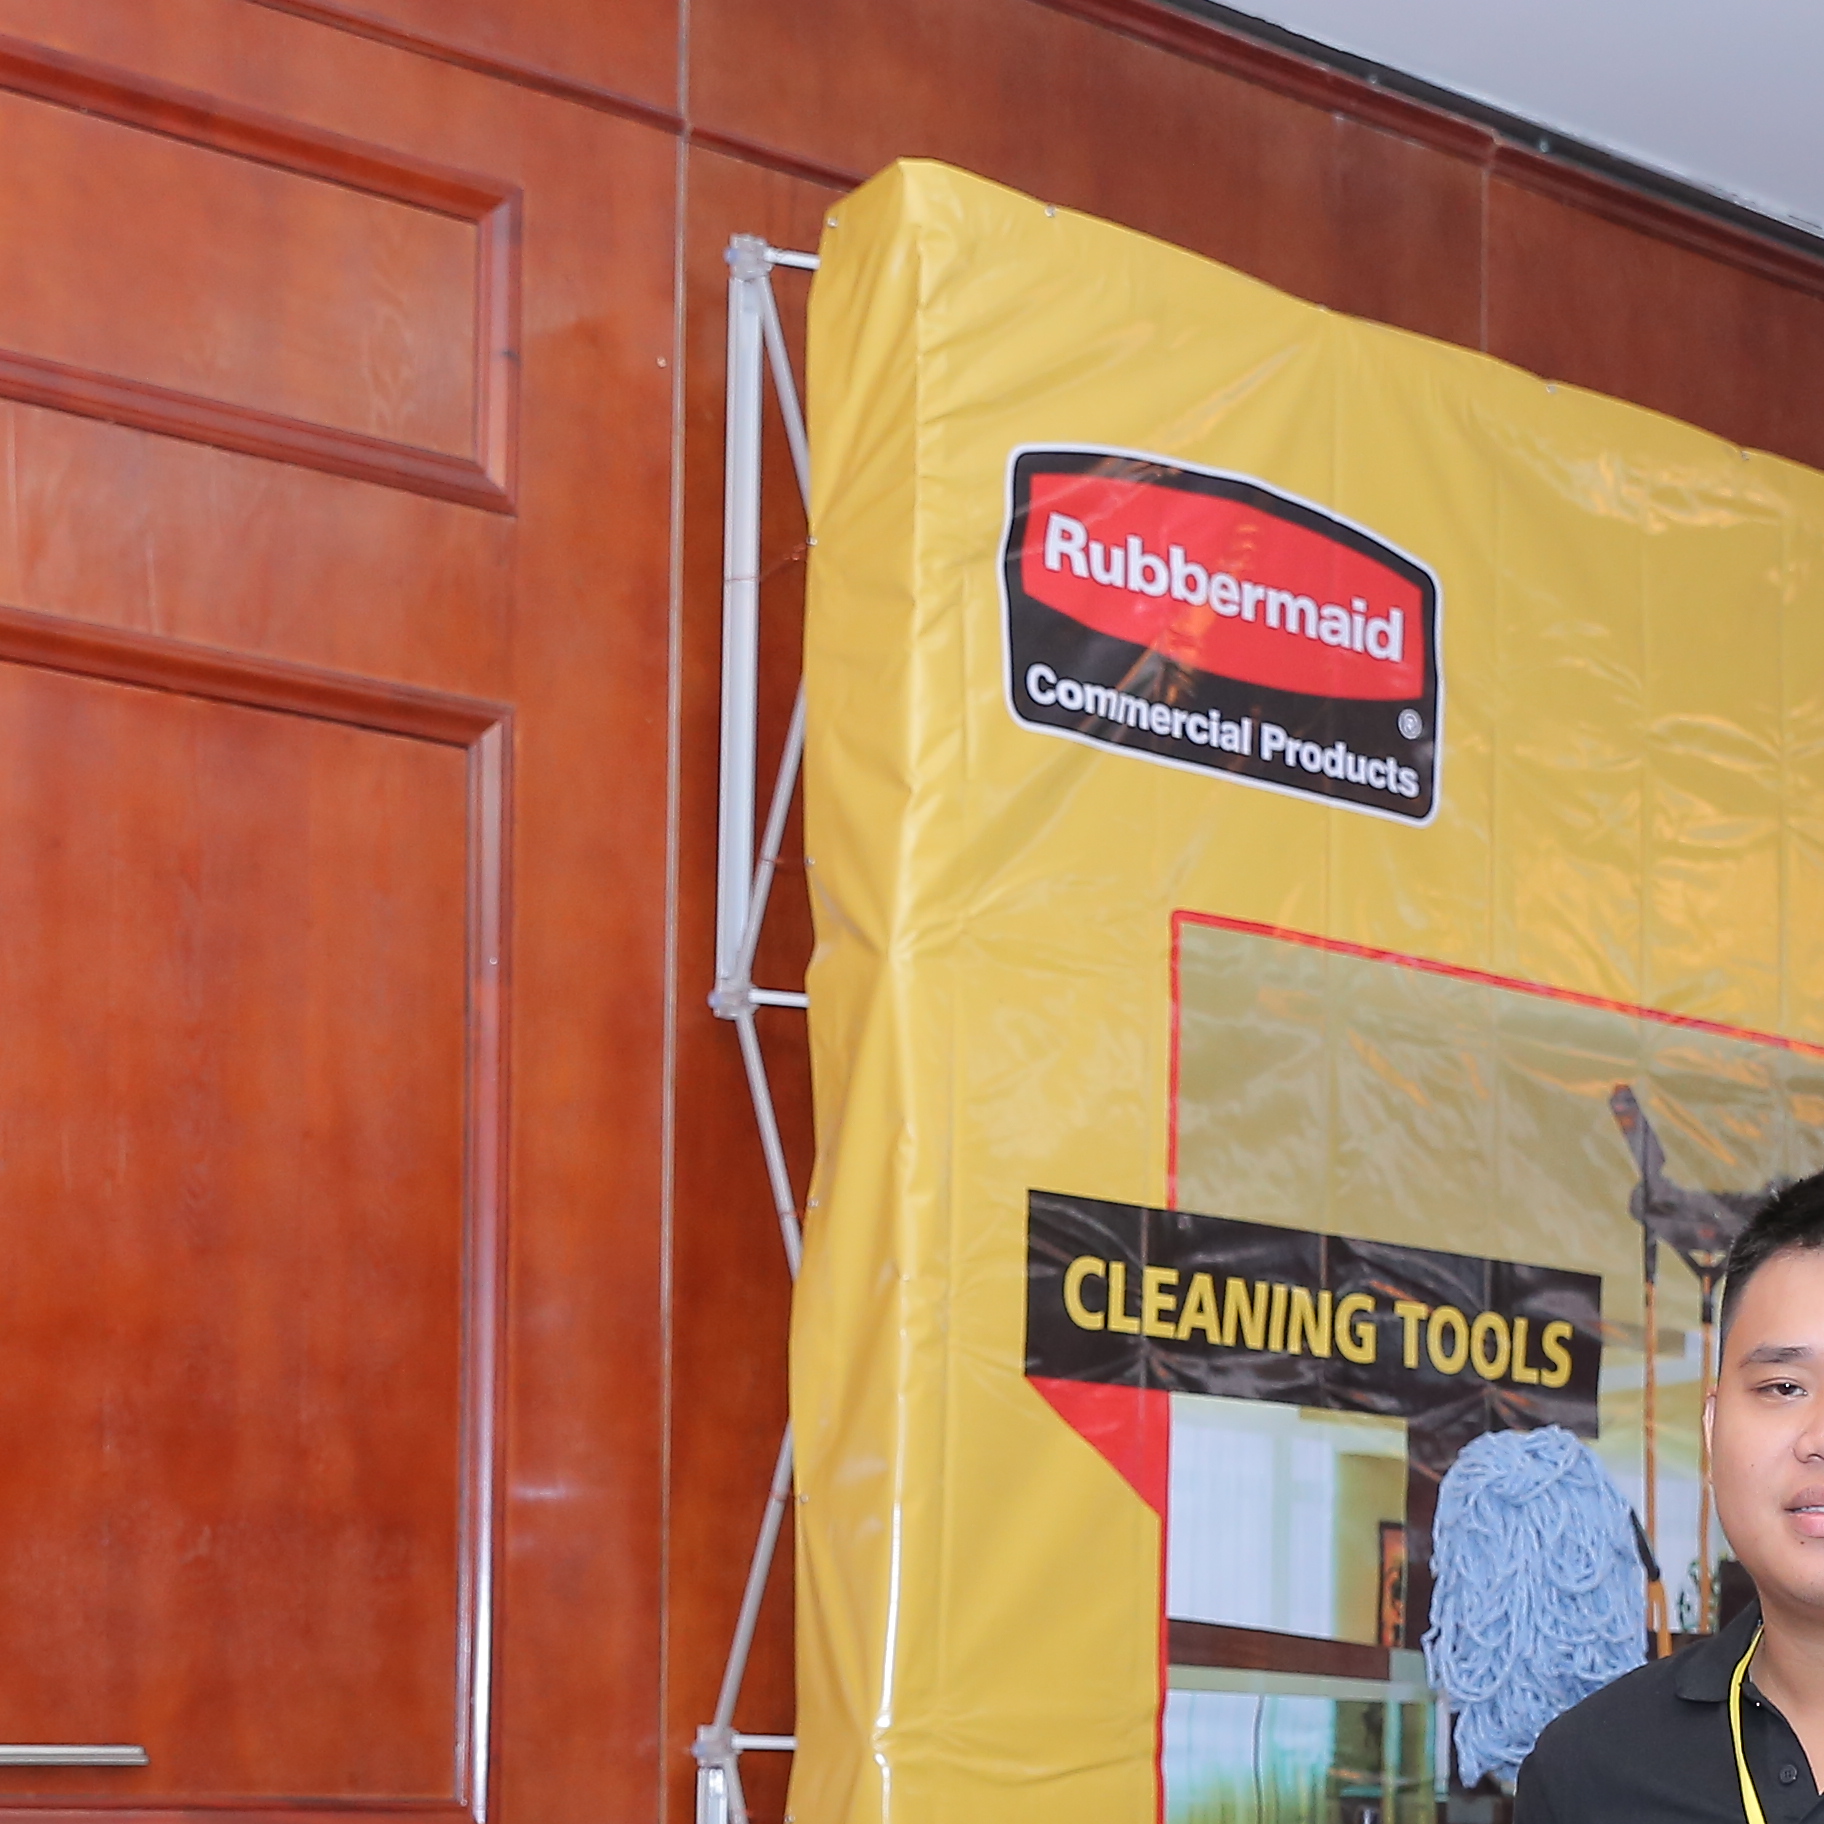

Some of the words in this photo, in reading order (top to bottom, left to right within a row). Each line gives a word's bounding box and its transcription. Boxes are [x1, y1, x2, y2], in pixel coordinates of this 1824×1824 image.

[1044, 511, 1404, 662] Rubbermaid
[1025, 662, 1252, 756] Commercial
[1260, 723, 1421, 799] Products
[1062, 1254, 1376, 1366] CLEANING
[1393, 1300, 1574, 1389] TOOLS
